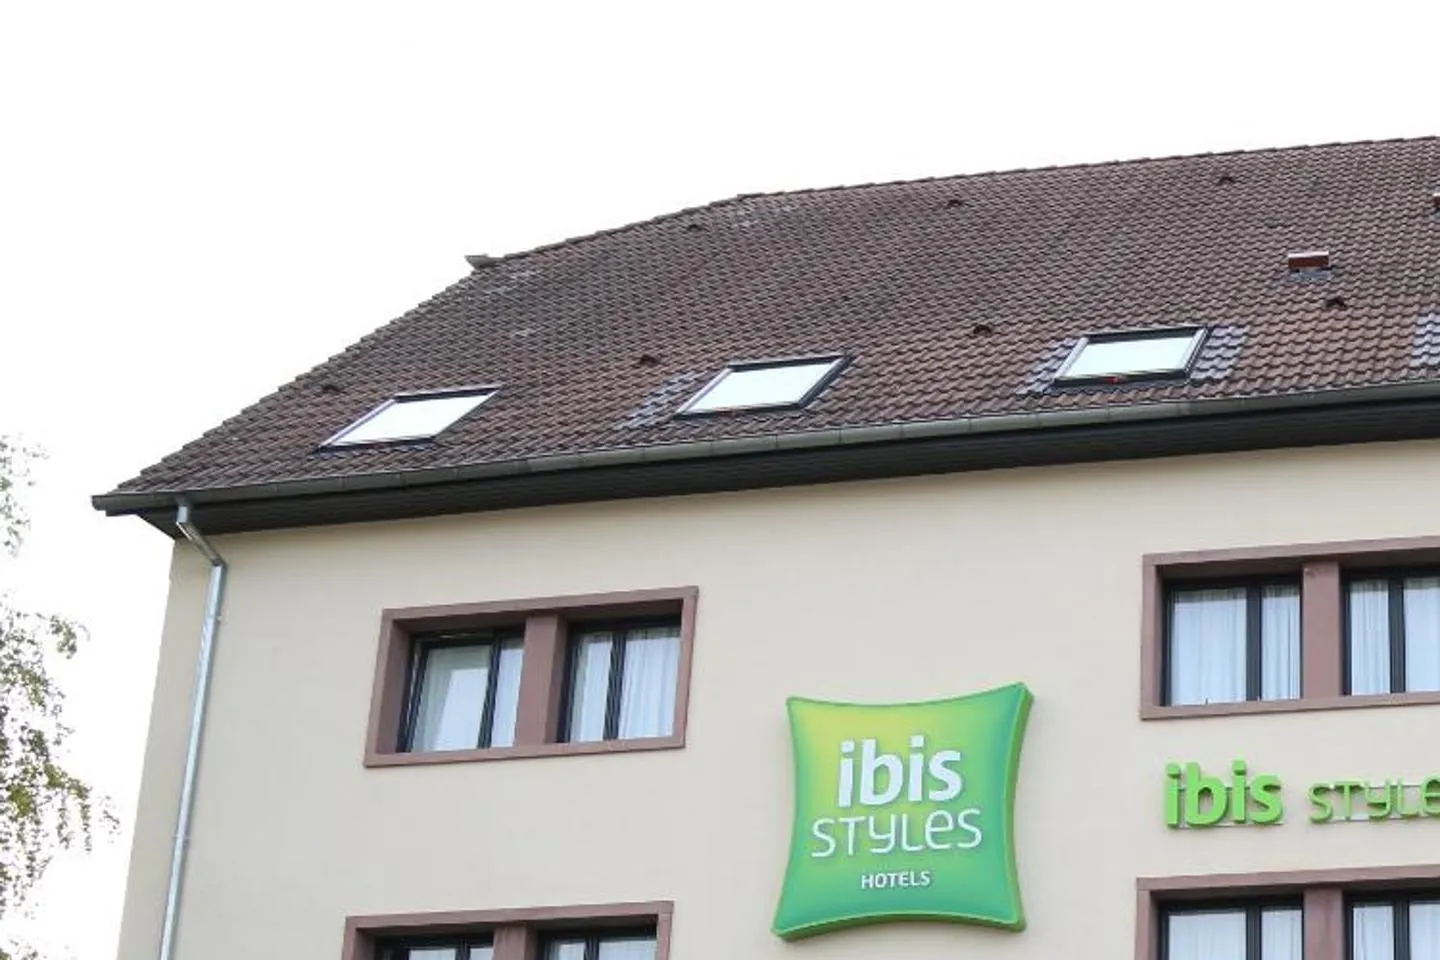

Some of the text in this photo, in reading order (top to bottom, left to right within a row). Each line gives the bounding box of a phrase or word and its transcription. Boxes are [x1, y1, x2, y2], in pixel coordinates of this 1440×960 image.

[838, 734, 964, 808] ibis
[1165, 759, 1283, 829] ibis
[861, 870, 931, 890] HOTELS
